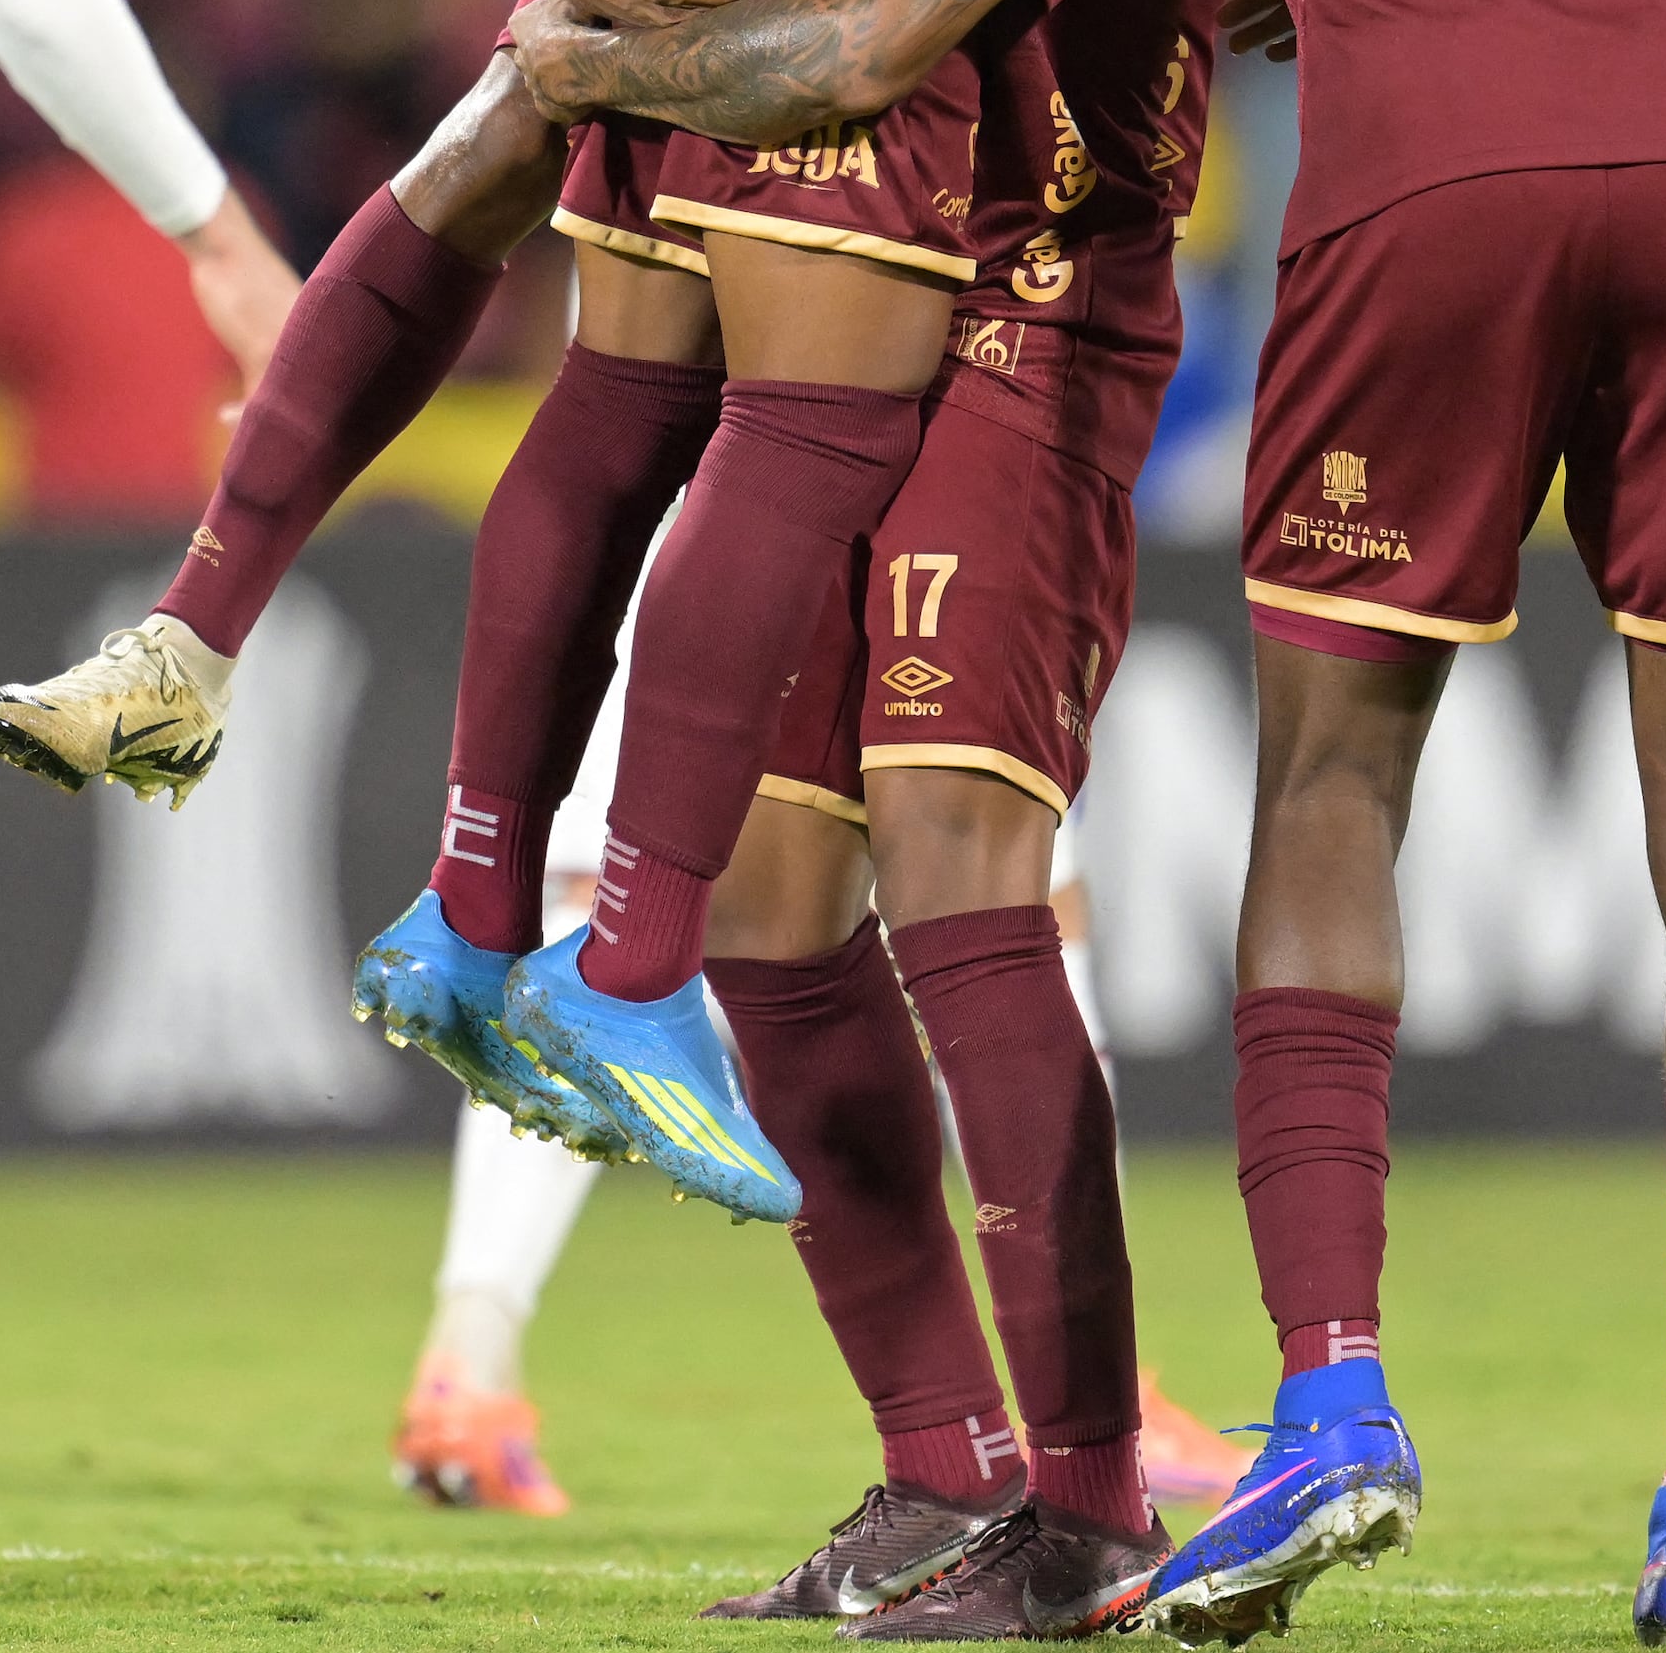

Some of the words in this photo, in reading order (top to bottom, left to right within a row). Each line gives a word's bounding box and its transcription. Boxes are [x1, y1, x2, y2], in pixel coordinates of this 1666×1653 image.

[1322, 451, 1368, 491] EXTRA
[1309, 517, 1371, 536] LOTERÍA
[1380, 528, 1408, 540] DEL
[1309, 530, 1413, 563] TOLIMA
[888, 553, 959, 638] 17
[884, 700, 944, 718] umbro
